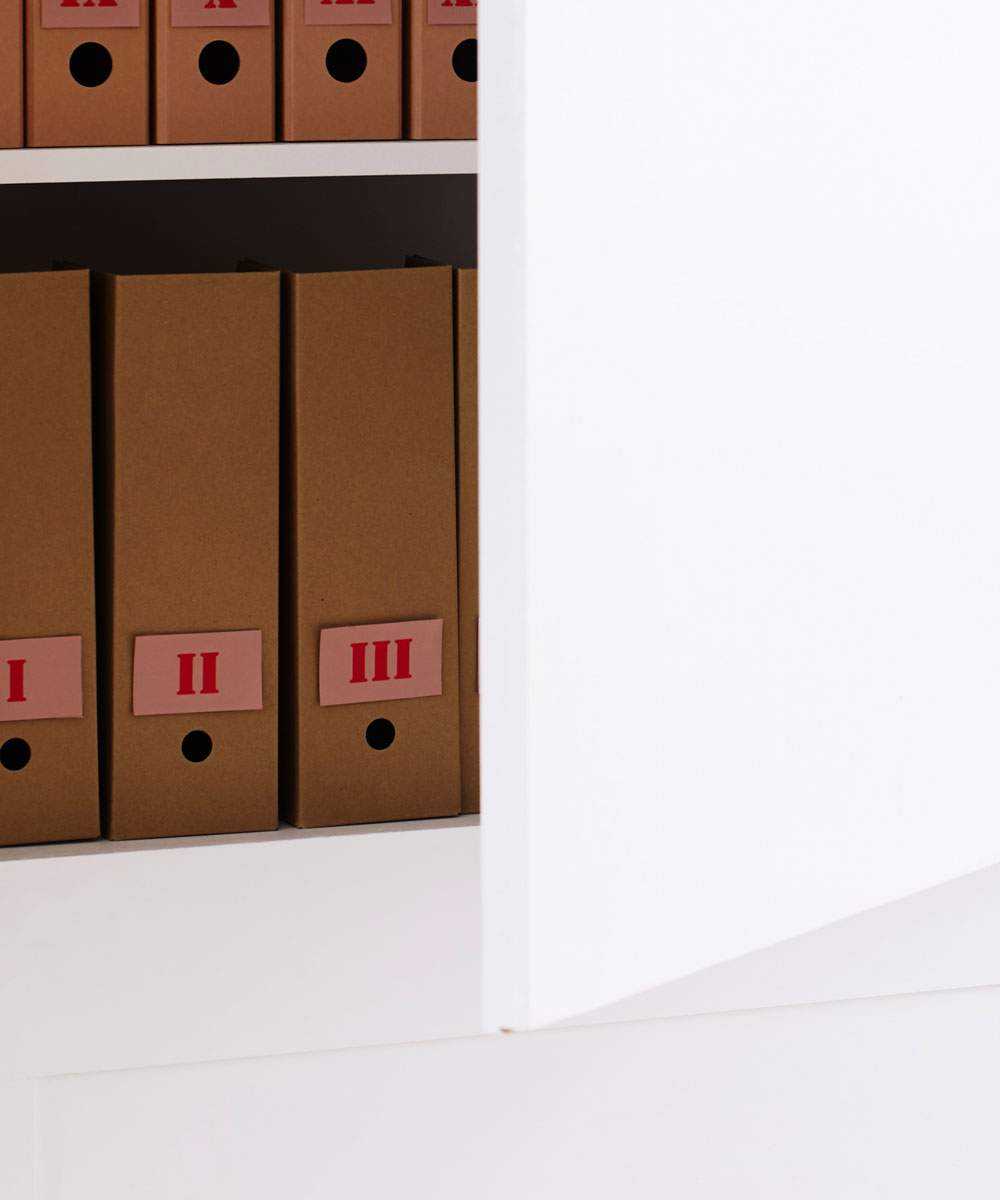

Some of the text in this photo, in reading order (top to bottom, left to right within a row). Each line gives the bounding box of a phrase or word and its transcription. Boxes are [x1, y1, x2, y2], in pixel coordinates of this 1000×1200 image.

[7, 659, 27, 702] I
[176, 652, 219, 695] II
[349, 638, 413, 683] III
